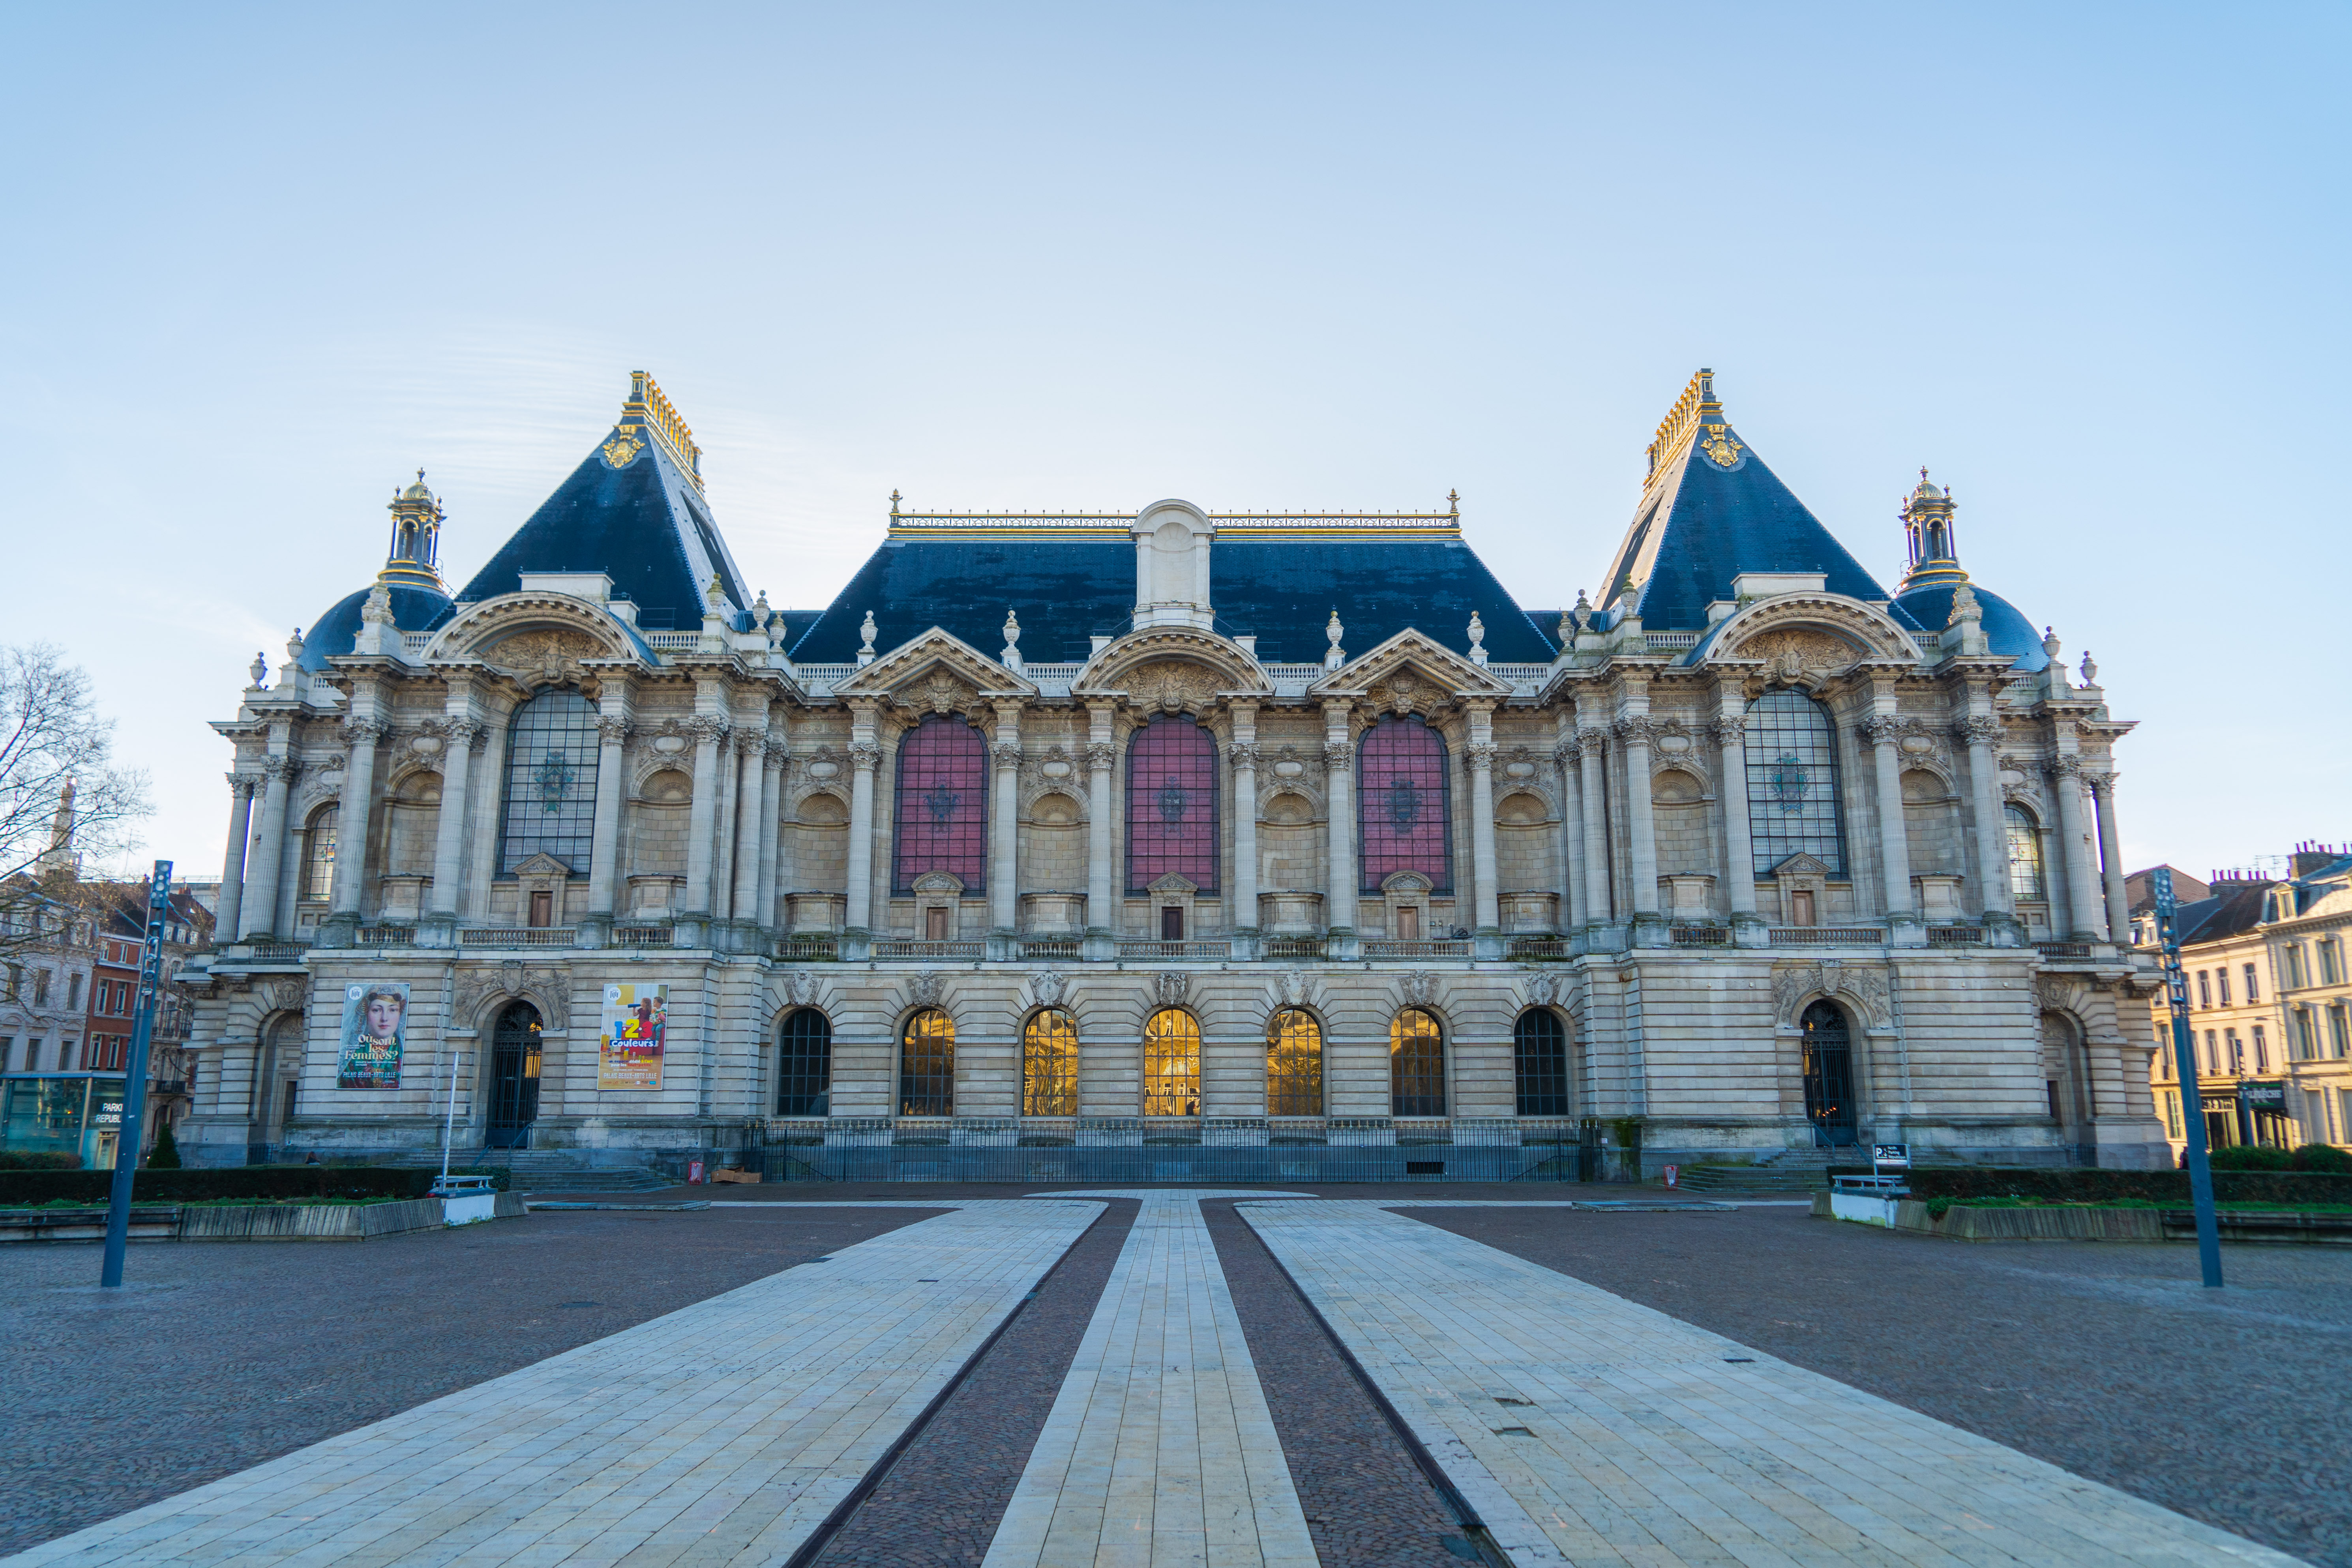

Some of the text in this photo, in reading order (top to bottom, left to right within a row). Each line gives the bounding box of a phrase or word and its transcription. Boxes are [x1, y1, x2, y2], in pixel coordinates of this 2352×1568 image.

[358, 1034, 396, 1045] Où sont
[611, 1038, 654, 1047] couleurs
[369, 1043, 384, 1053] les
[1876, 1147, 1882, 1157] P
